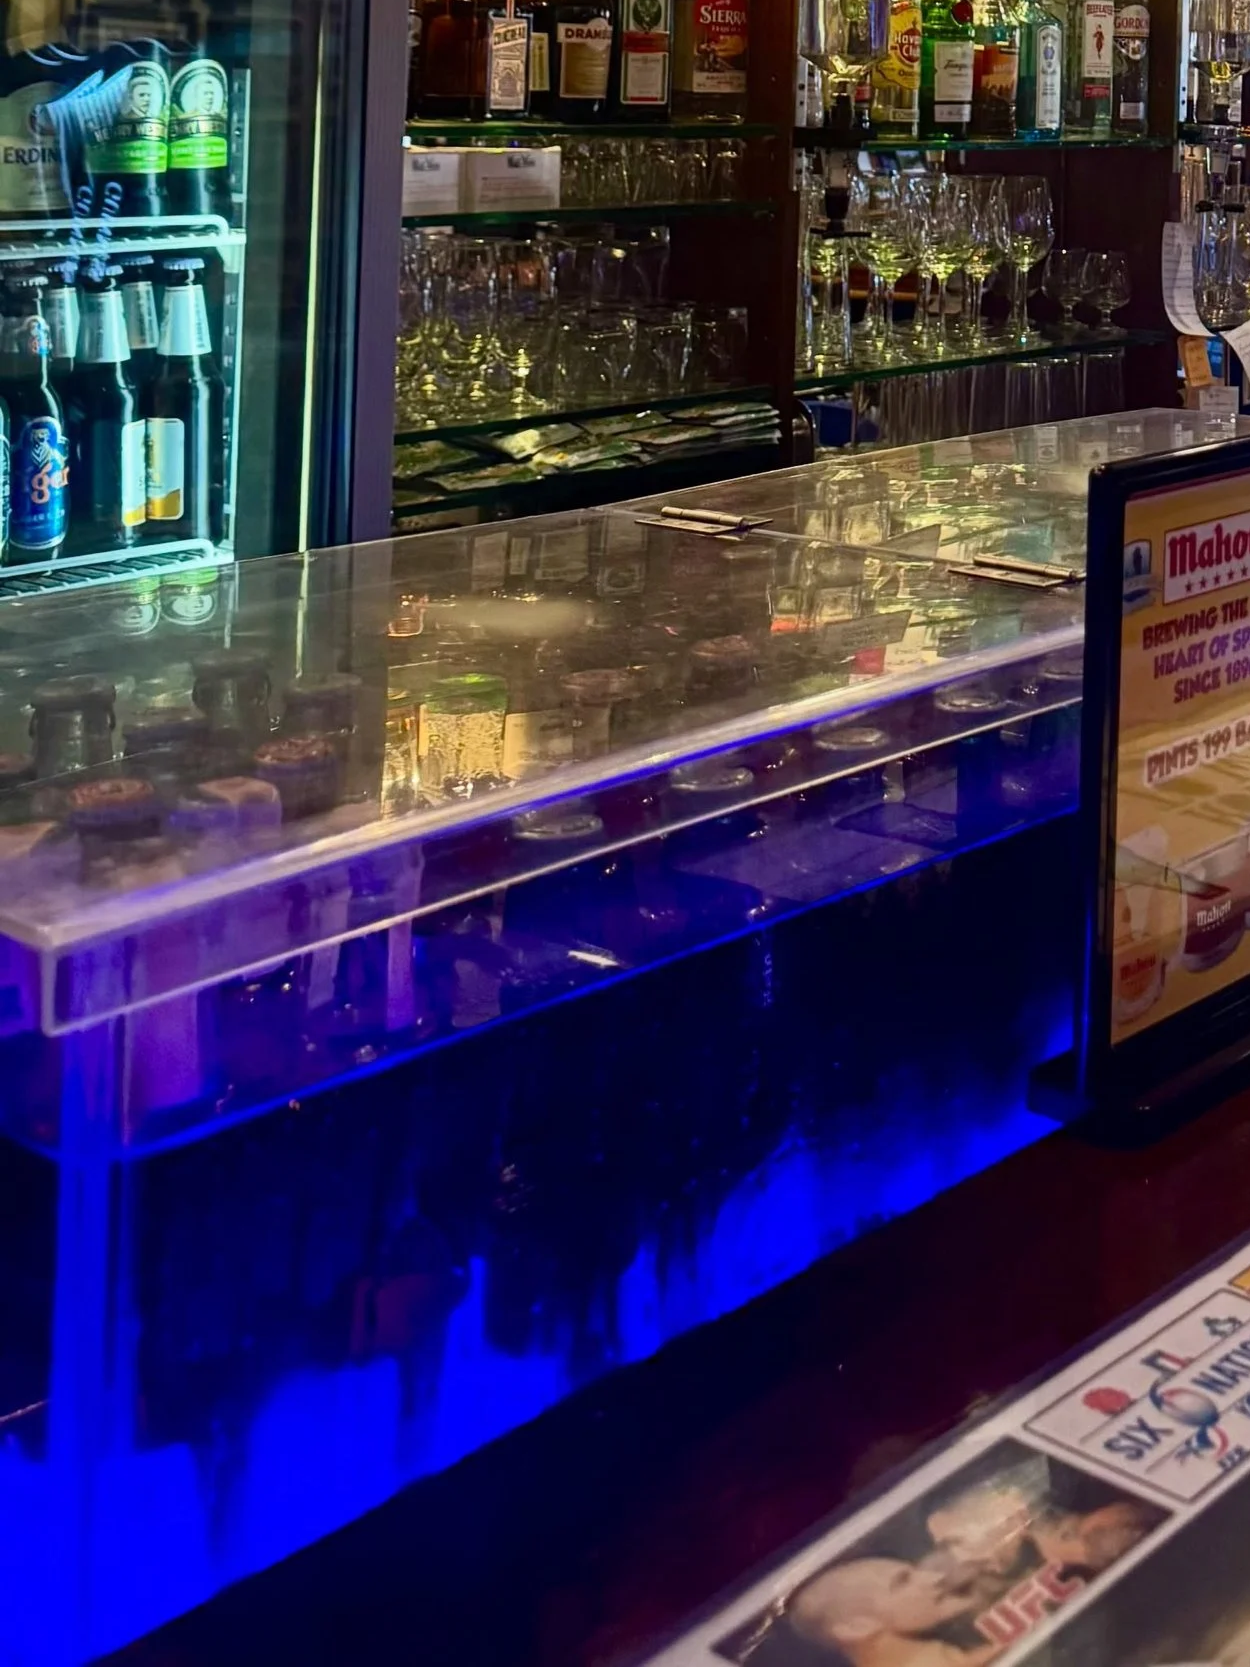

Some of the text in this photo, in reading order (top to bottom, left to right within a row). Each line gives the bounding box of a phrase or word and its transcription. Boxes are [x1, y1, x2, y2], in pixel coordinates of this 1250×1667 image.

[700, 3, 746, 24] SIERRA
[1143, 608, 1218, 651] BREWING
[1221, 597, 1248, 625] THE
[1154, 644, 1205, 680] HEART
[1208, 635, 1228, 661] OF
[1173, 667, 1221, 705] SINCE
[1147, 738, 1199, 784] PINTS
[1202, 726, 1232, 761] 199
[1197, 900, 1232, 927] Mahou
[1103, 1418, 1174, 1460] SIX
[975, 1561, 1086, 1648] UFC
